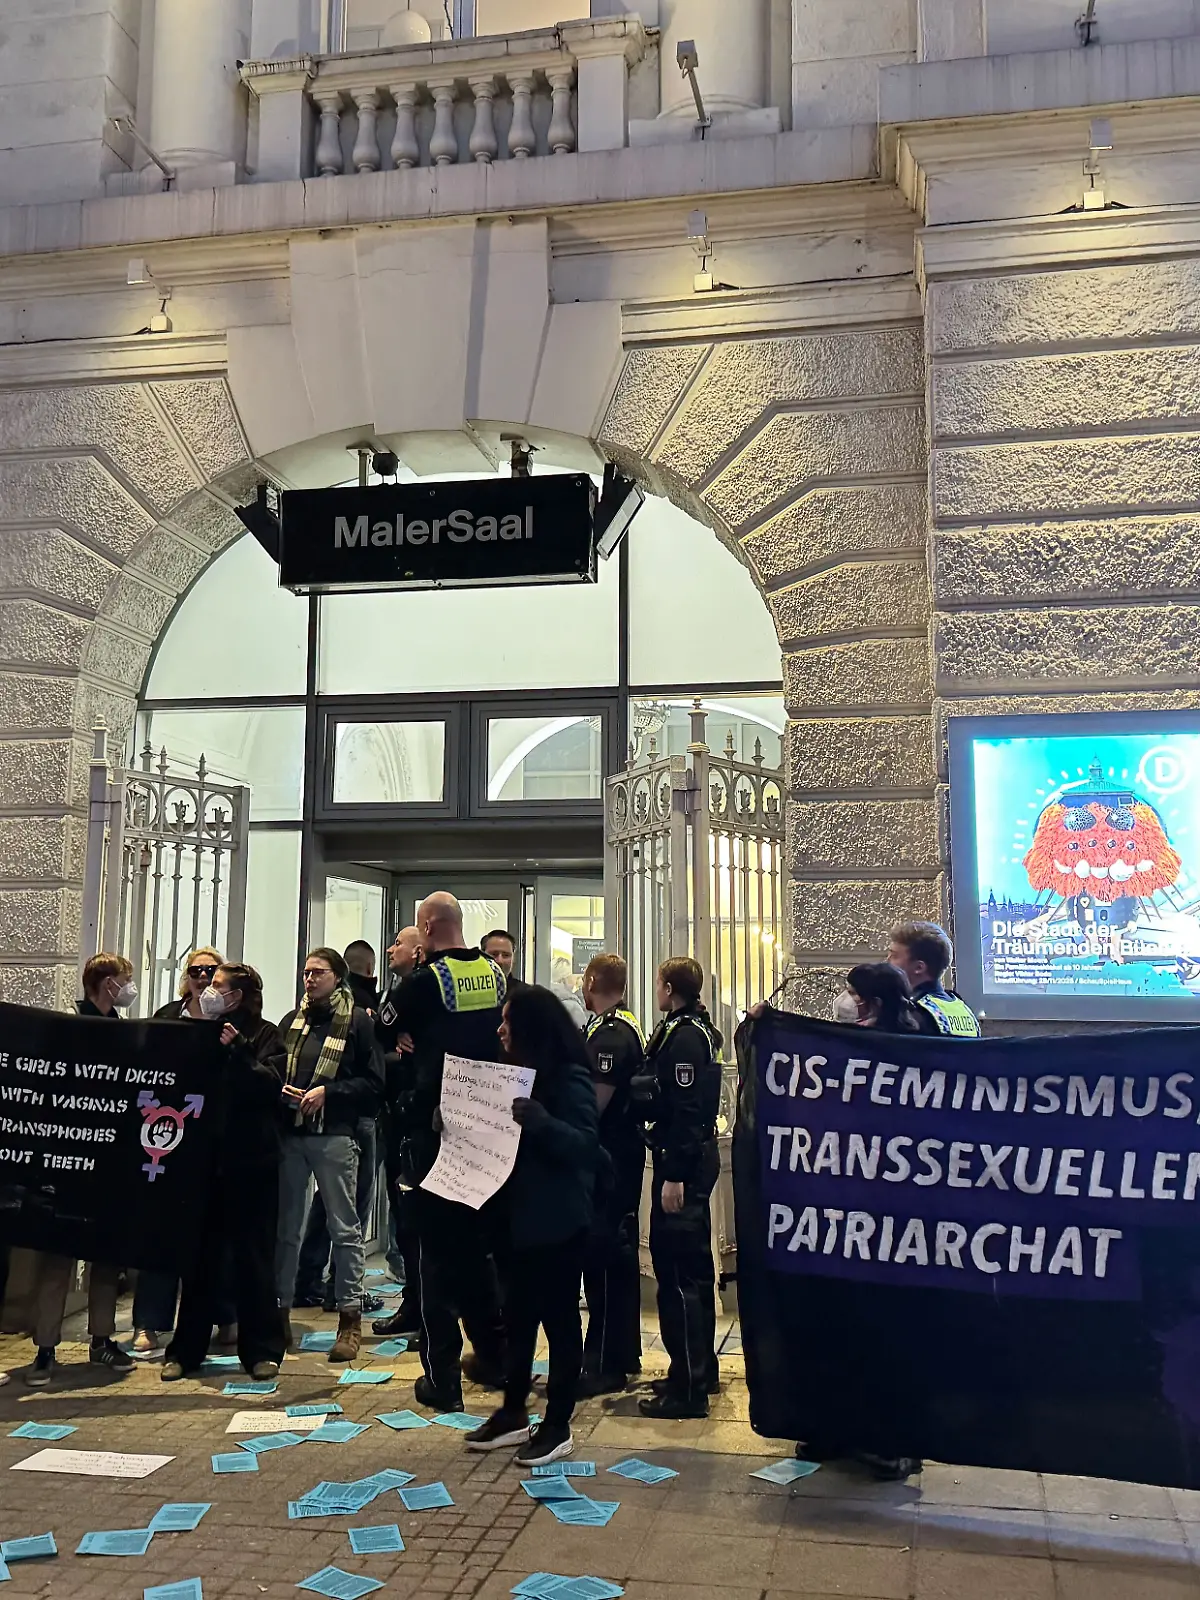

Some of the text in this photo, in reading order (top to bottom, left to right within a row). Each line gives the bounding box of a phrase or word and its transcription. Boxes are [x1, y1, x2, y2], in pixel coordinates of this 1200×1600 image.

[334, 506, 534, 549] MalerSaal
[1154, 756, 1179, 783] D
[993, 939, 1111, 956] Träumenden
[457, 974, 495, 993] POLIZEI
[948, 1015, 975, 1032] POLIZEI
[15, 1056, 68, 1078] GIRLS
[74, 1063, 120, 1083] WITH
[124, 1067, 177, 1087] DICKS
[1, 1085, 129, 1114] WITH VAGINAS
[43, 1152, 96, 1172] TEETH
[767, 1203, 1123, 1278] PATRIARCHAT
